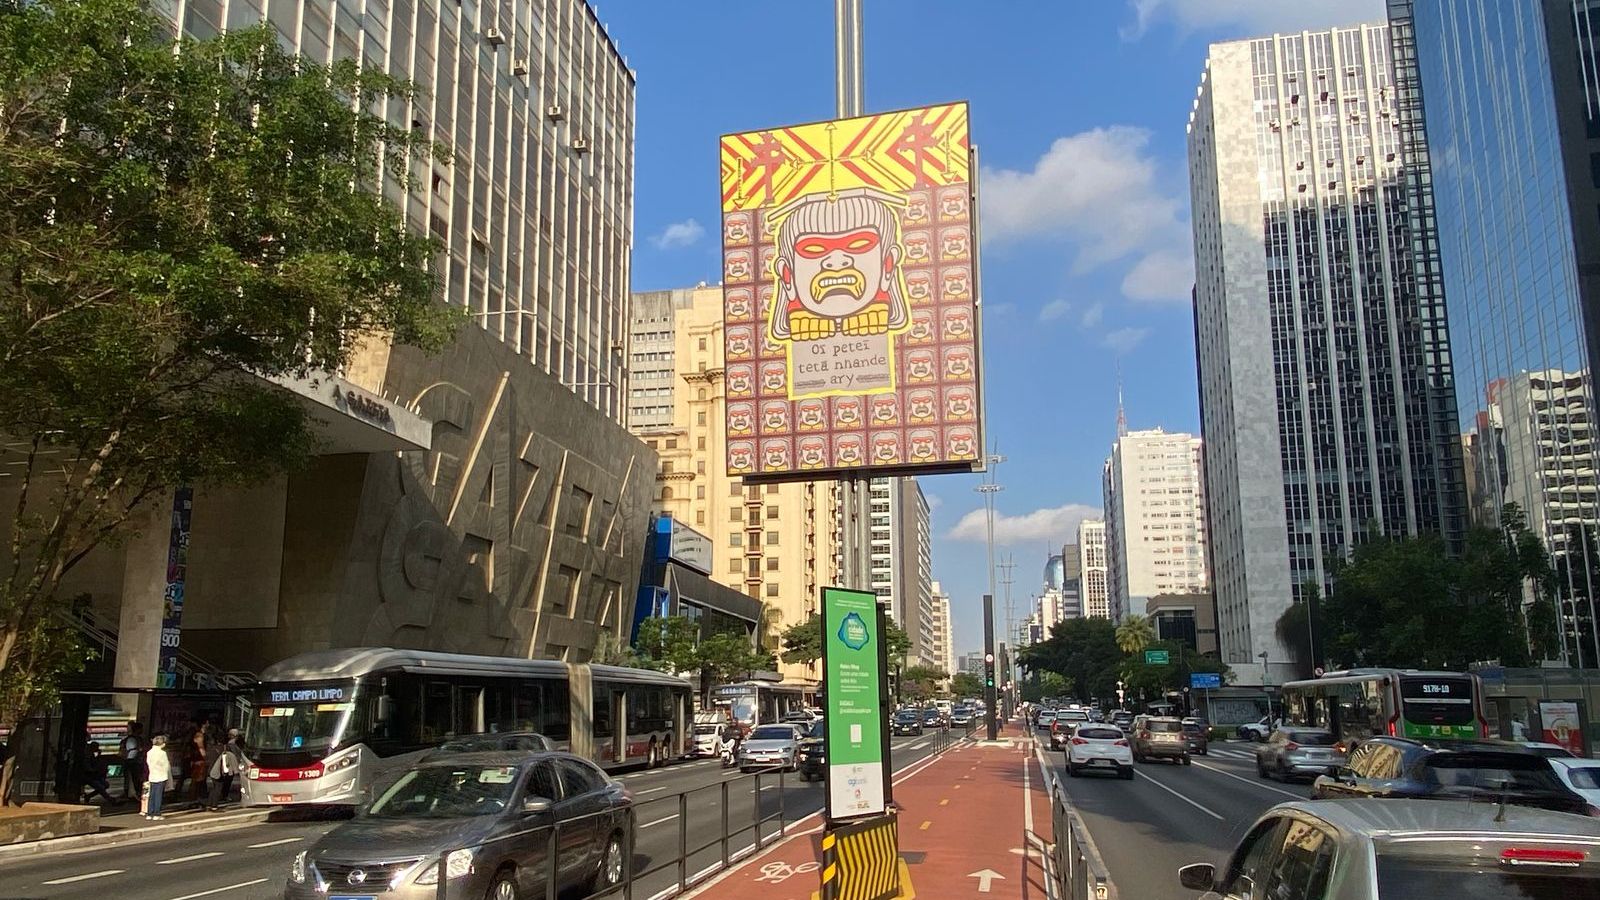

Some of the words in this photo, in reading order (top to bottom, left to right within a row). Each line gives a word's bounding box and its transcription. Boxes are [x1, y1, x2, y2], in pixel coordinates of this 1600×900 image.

[834, 355, 887, 370] nhande
[830, 373, 854, 387] ary
[161, 634, 180, 647] 900
[292, 689, 318, 701] CAMPO
[319, 688, 343, 700] LIMPO
